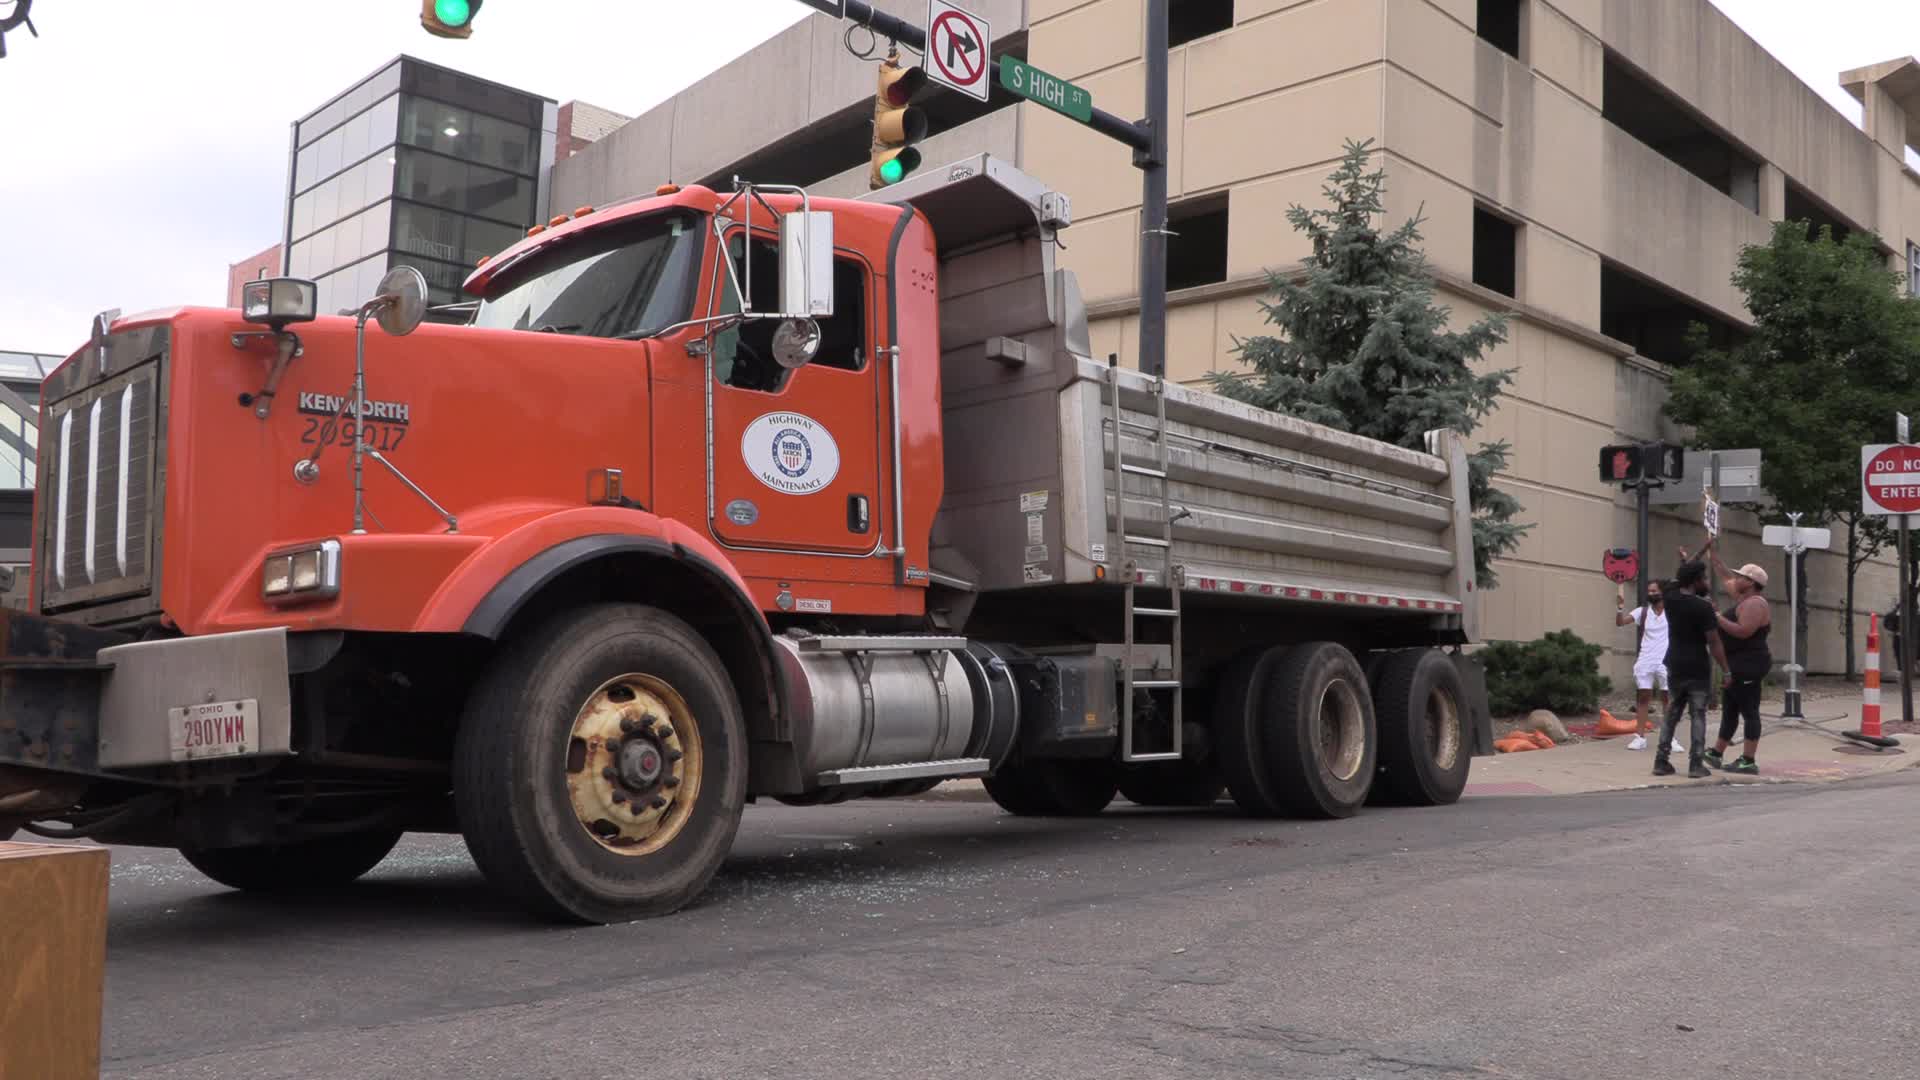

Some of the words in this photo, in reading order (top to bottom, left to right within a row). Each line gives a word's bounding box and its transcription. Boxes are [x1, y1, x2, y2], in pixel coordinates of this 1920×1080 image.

[1013, 65, 1023, 88] S
[1030, 71, 1064, 107] HIGH
[1072, 90, 1083, 104] ST
[299, 391, 409, 420] KENWORTH
[301, 417, 406, 451] 209017
[768, 415, 814, 430] HIGHWAY
[1875, 460, 1895, 471] DO
[1903, 459, 1920, 471] NO
[762, 471, 822, 491] MAINTENANCE
[200, 705, 223, 714] OHIO
[184, 715, 245, 748] 290YWM
